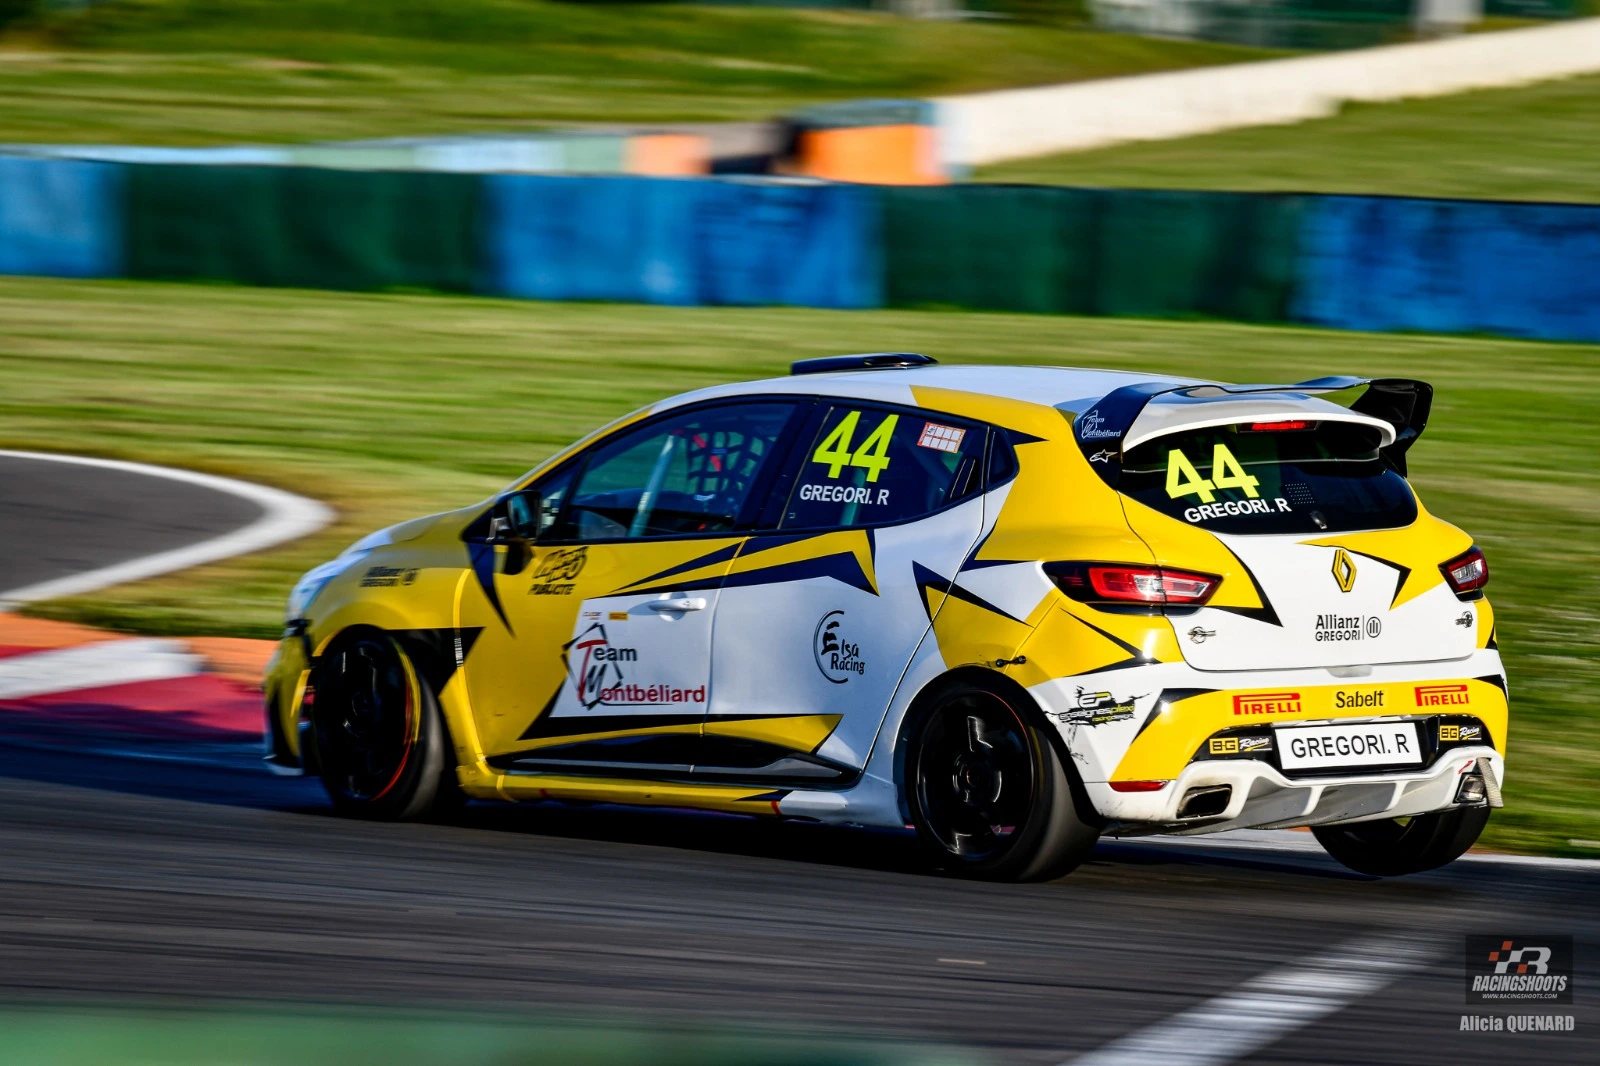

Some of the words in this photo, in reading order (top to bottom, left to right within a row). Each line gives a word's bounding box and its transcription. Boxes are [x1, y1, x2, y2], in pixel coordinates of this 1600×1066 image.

[811, 410, 900, 483] 44
[1165, 443, 1260, 504] 44
[800, 484, 873, 504] GREGORI.
[876, 488, 890, 505] R
[1184, 499, 1275, 523] GREGORI.
[1274, 498, 1293, 513] R
[1315, 614, 1360, 629] Allianz
[821, 621, 860, 660] Elsa
[1315, 630, 1361, 642] GREGORI
[830, 653, 866, 675] Racing
[586, 663, 706, 706] Montbéliard
[1414, 685, 1470, 707] PIRELLI
[1232, 692, 1302, 716] PIRELLI
[1335, 690, 1385, 709] Sabelt
[1239, 737, 1270, 750] Racing
[1291, 734, 1392, 759] GREGORI.
[1394, 733, 1411, 754] R
